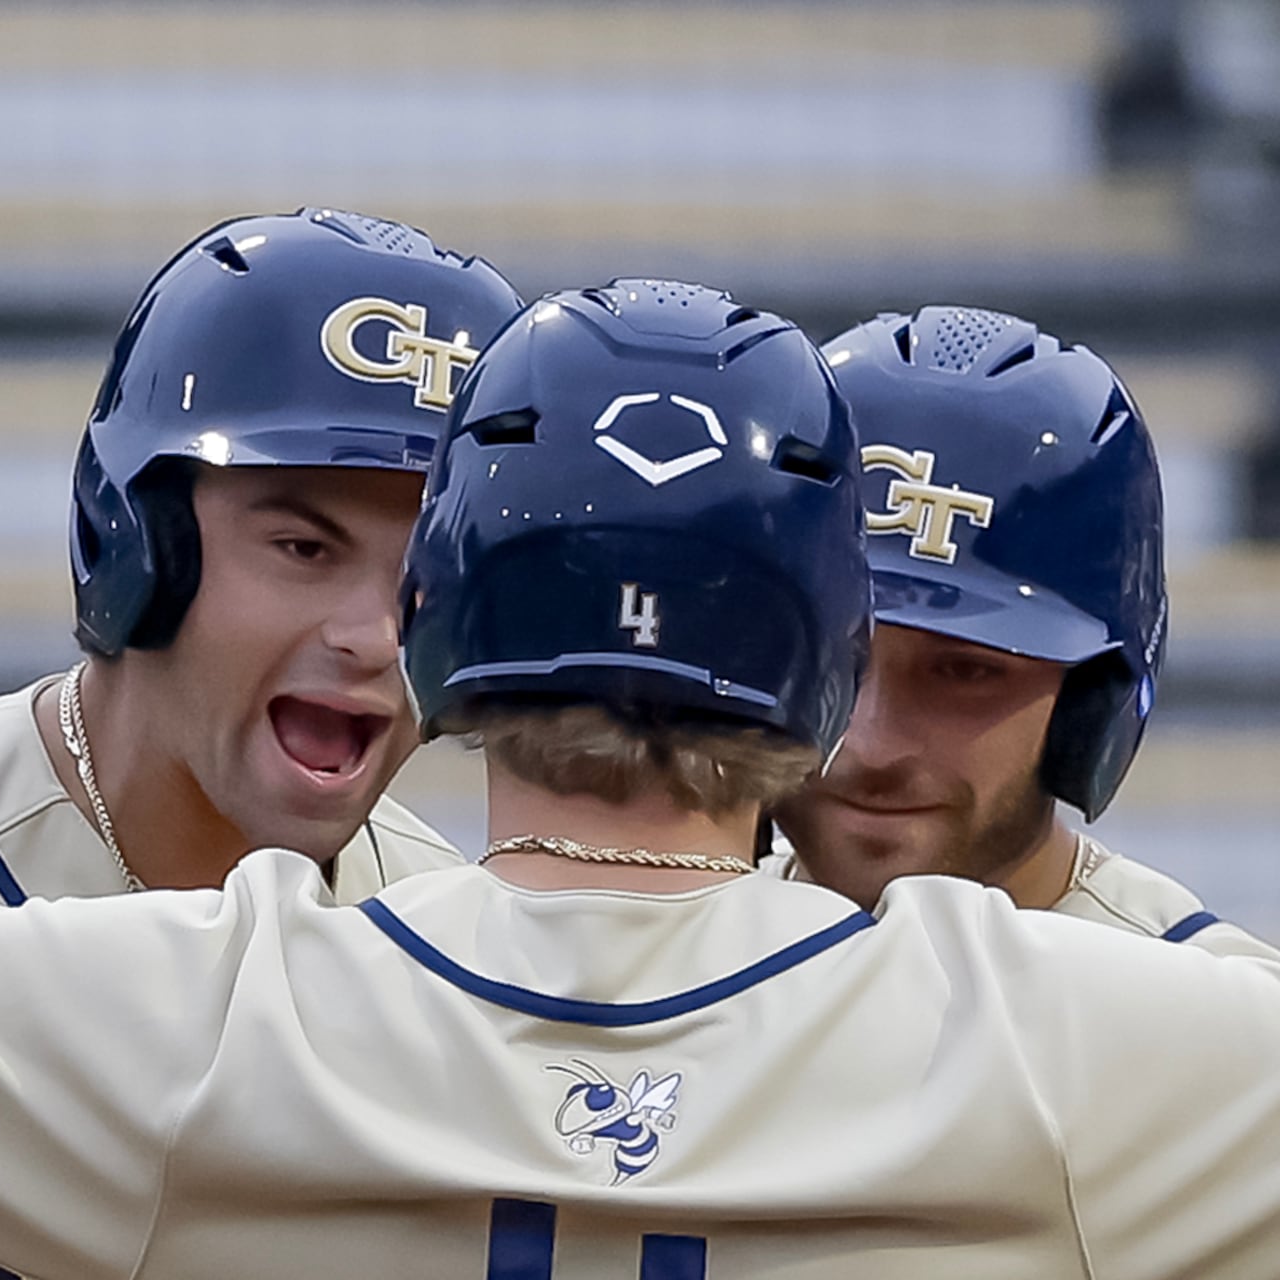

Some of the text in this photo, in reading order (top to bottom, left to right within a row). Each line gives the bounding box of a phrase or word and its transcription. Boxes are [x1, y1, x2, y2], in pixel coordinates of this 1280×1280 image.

[321, 296, 480, 414] GT
[860, 444, 995, 565] GT
[619, 581, 659, 648] 4
